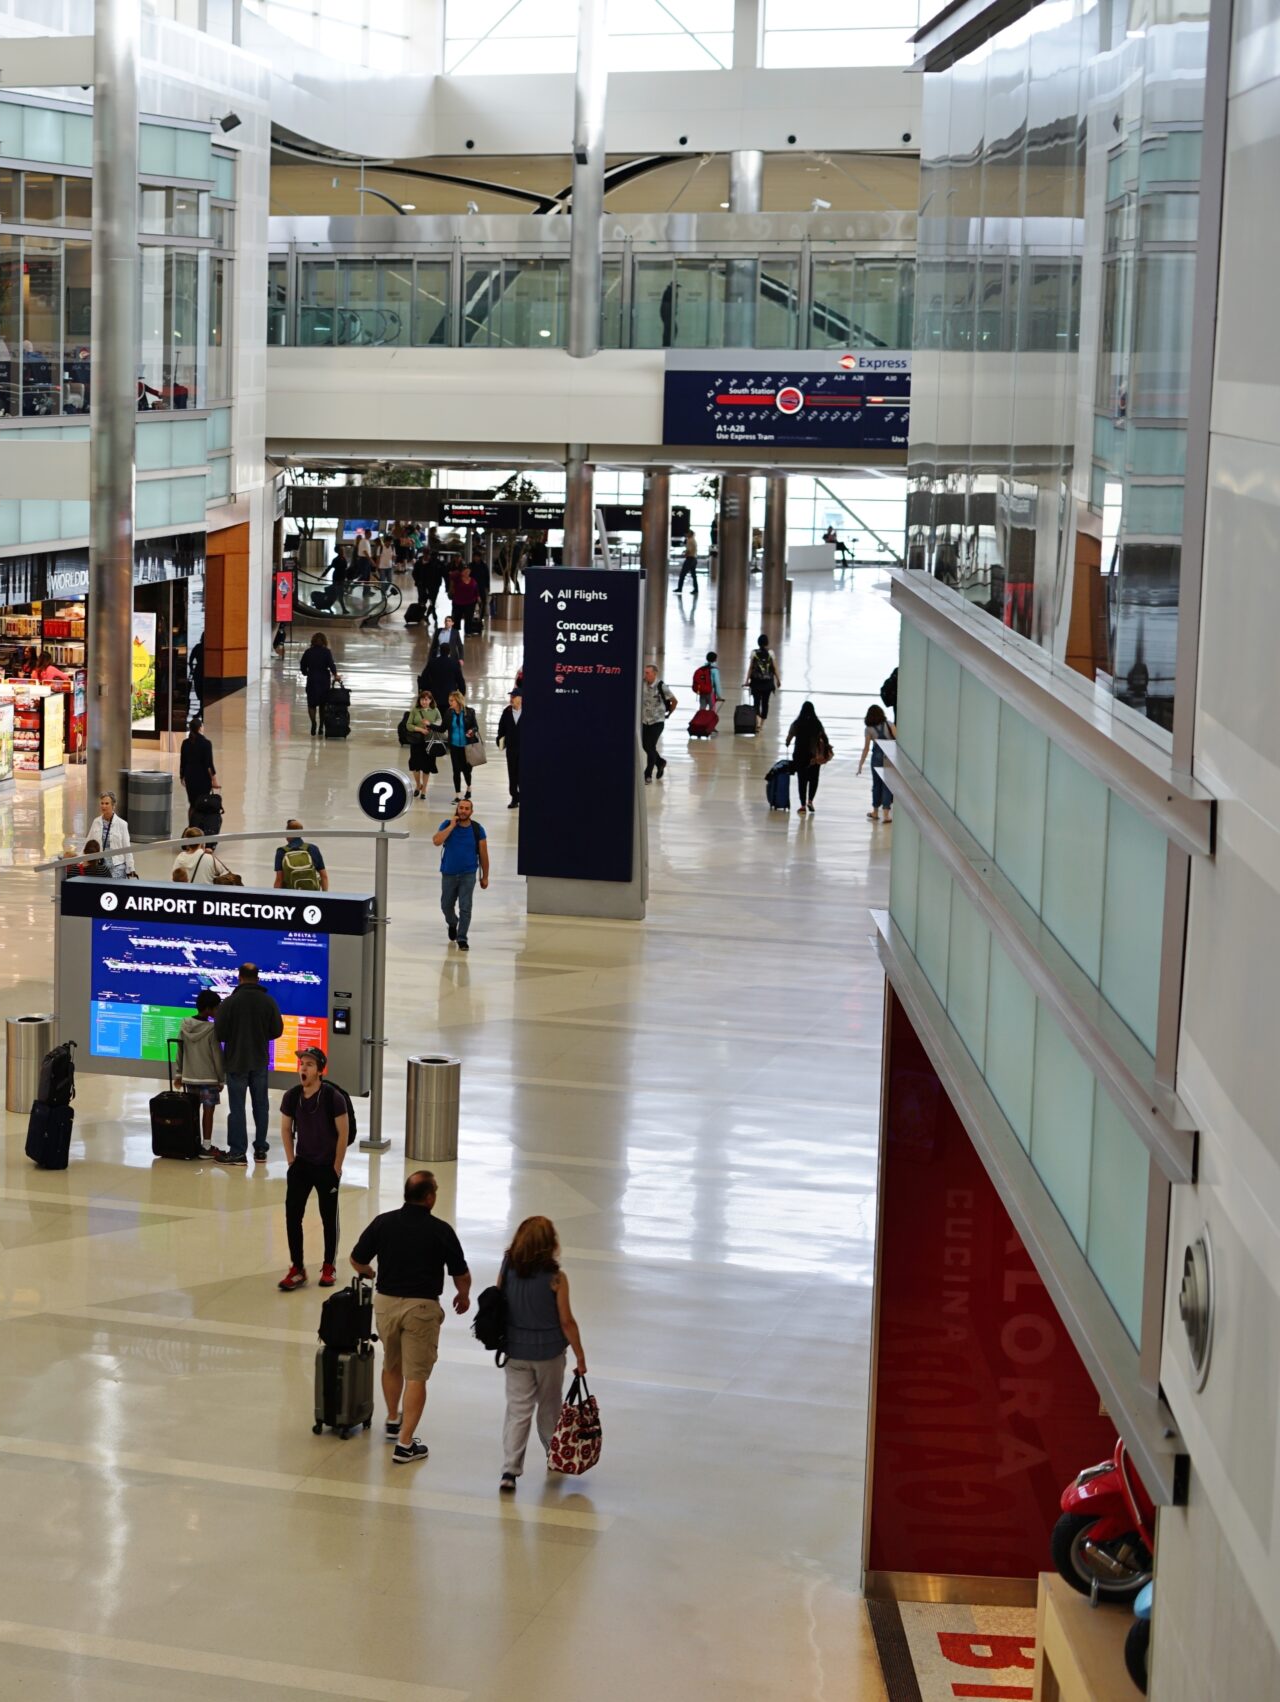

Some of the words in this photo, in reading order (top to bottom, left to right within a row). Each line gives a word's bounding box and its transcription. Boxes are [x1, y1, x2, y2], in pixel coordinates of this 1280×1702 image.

[858, 357, 908, 370] Express
[716, 424, 746, 432] A1-A28
[558, 589, 572, 600] All
[574, 590, 608, 602] Flights
[556, 620, 614, 632] Concourses
[556, 632, 567, 642] A,
[570, 633, 577, 642] B
[579, 633, 599, 642] and
[601, 634, 608, 642] C
[555, 663, 594, 674] Express
[596, 664, 621, 674] Tram
[124, 896, 196, 915] AIRPORT
[202, 900, 296, 921] DIRECTORY
